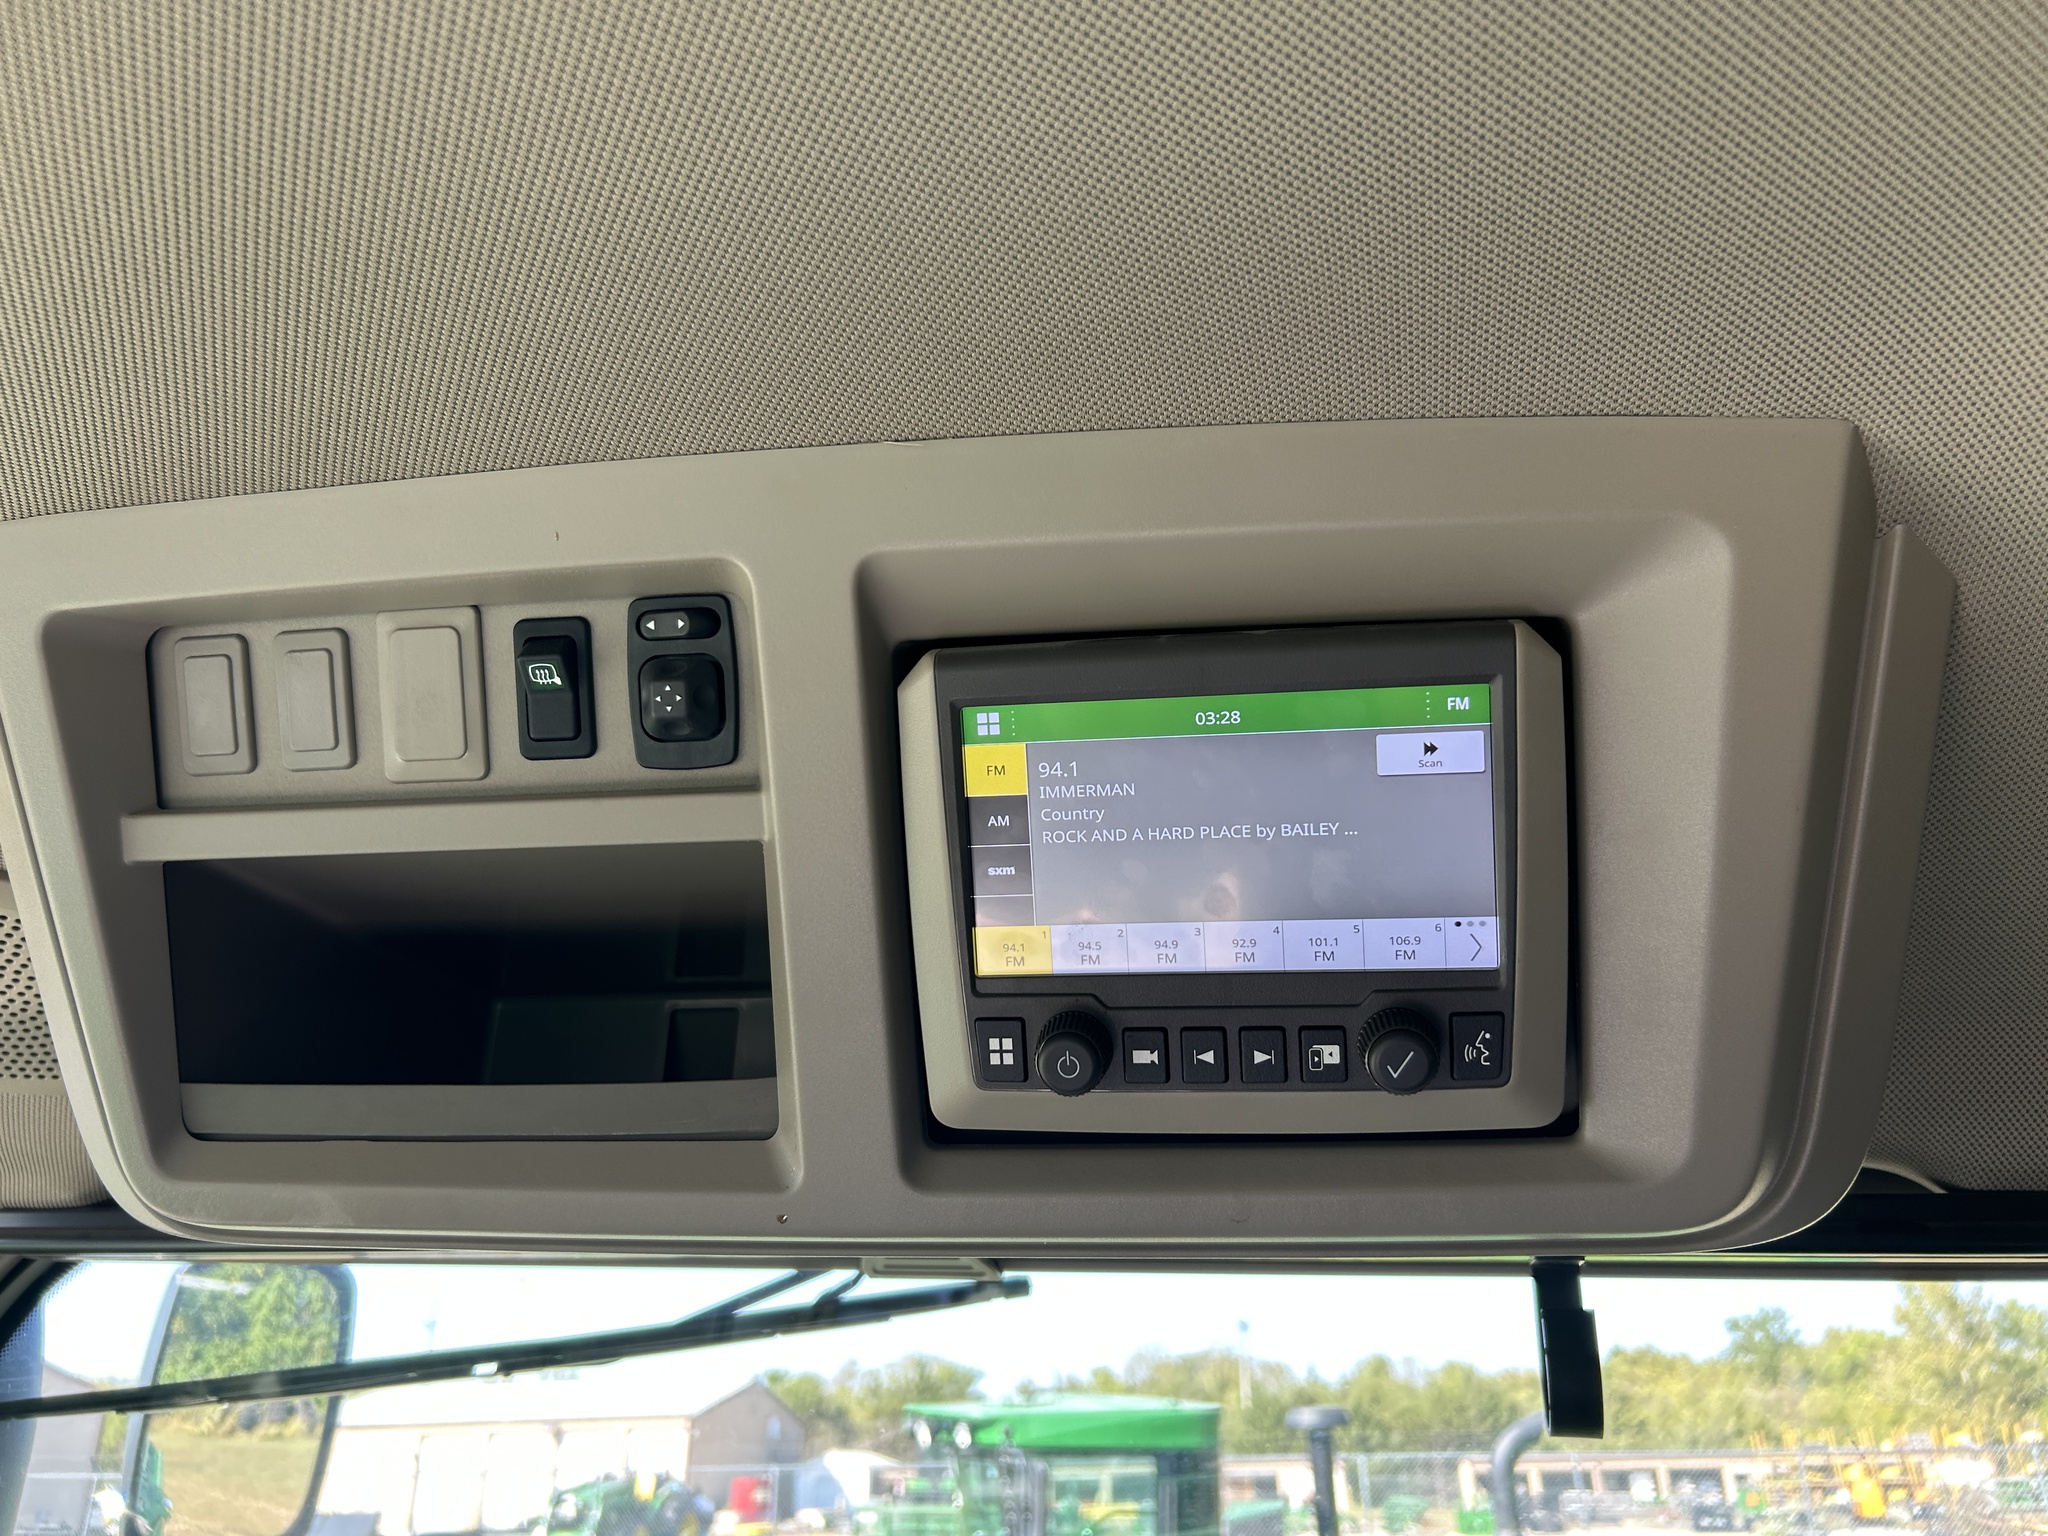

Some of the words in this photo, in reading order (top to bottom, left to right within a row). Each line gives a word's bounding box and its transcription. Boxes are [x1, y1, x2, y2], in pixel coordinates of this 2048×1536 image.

[1447, 696, 1470, 711] FM
[1195, 710, 1241, 725] 03:28
[1418, 759, 1443, 768] Scan
[986, 764, 1006, 776] FM
[1038, 761, 1078, 778] 94.1
[1039, 783, 1136, 799] IMMERMAN
[1041, 807, 1105, 822] Country
[987, 815, 1010, 827] AM
[1043, 830, 1088, 844] ROCK
[1091, 828, 1127, 842] AND
[1132, 828, 1144, 841] A
[1148, 826, 1195, 840] HARD
[1200, 824, 1251, 839] PLACE
[1256, 824, 1276, 840] by
[1281, 822, 1340, 837] BAILEY
[987, 866, 1016, 876] sxm
[1194, 927, 1201, 936] 3
[1272, 926, 1280, 935] 4
[1353, 924, 1360, 933] 5
[1434, 923, 1442, 932] 6
[1117, 929, 1124, 938] 2
[1078, 941, 1102, 951] 94.5
[1154, 940, 1179, 950] 94.9
[1232, 938, 1257, 948] 92.9
[1308, 937, 1339, 947] 101.1
[1389, 936, 1422, 946] 106.9
[1002, 943, 1025, 953] 94.1
[1080, 954, 1101, 965] FM
[1157, 953, 1177, 964] FM
[1235, 951, 1255, 963] FM
[1314, 950, 1335, 962] FM
[1395, 949, 1416, 961] FM
[1005, 956, 1025, 967] FM
